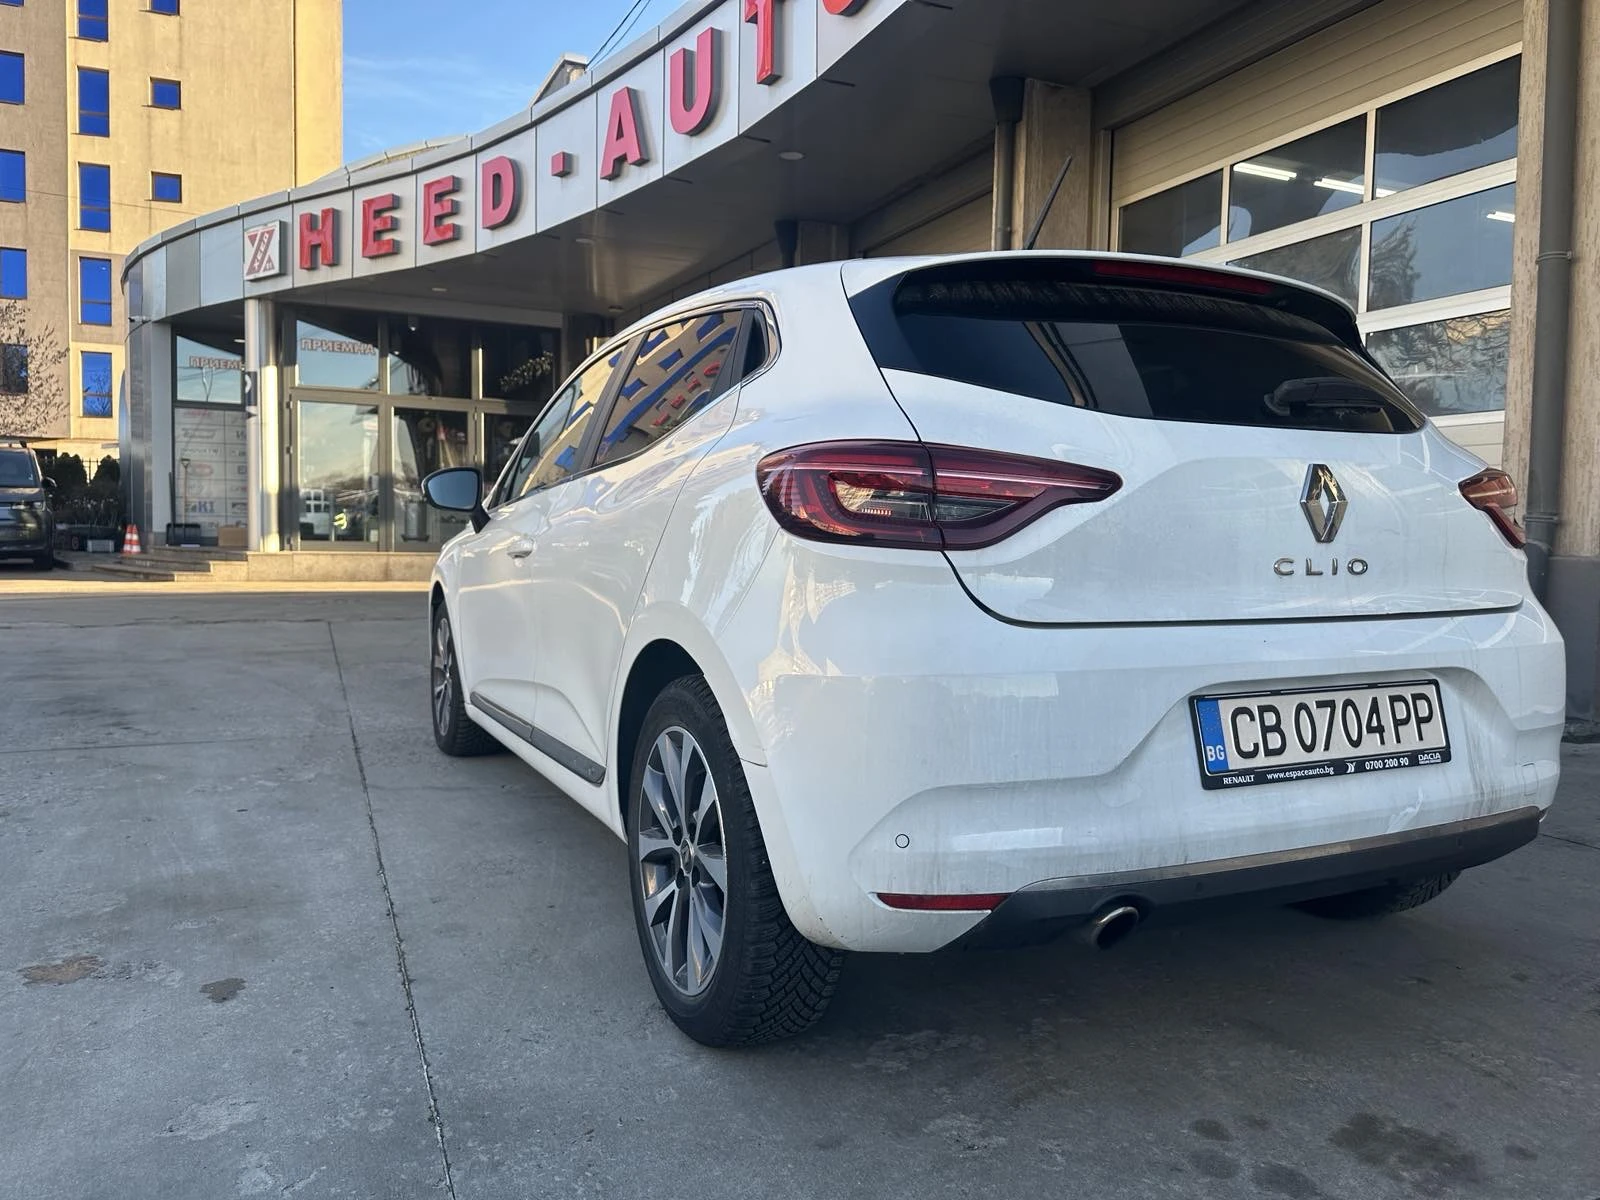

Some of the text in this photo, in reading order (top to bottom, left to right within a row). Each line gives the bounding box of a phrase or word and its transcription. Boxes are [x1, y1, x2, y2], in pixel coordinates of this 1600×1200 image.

[299, 156, 522, 271] HEED
[1273, 557, 1369, 576] CLIO
[1206, 745, 1225, 761] BG
[1223, 775, 1255, 785] RENAULT
[1266, 765, 1335, 780] www.espaceauto.bg
[1365, 760, 1383, 770] 0700
[1385, 758, 1398, 768] 200
[1399, 757, 1409, 766] 90
[1418, 752, 1441, 761] DACIA
